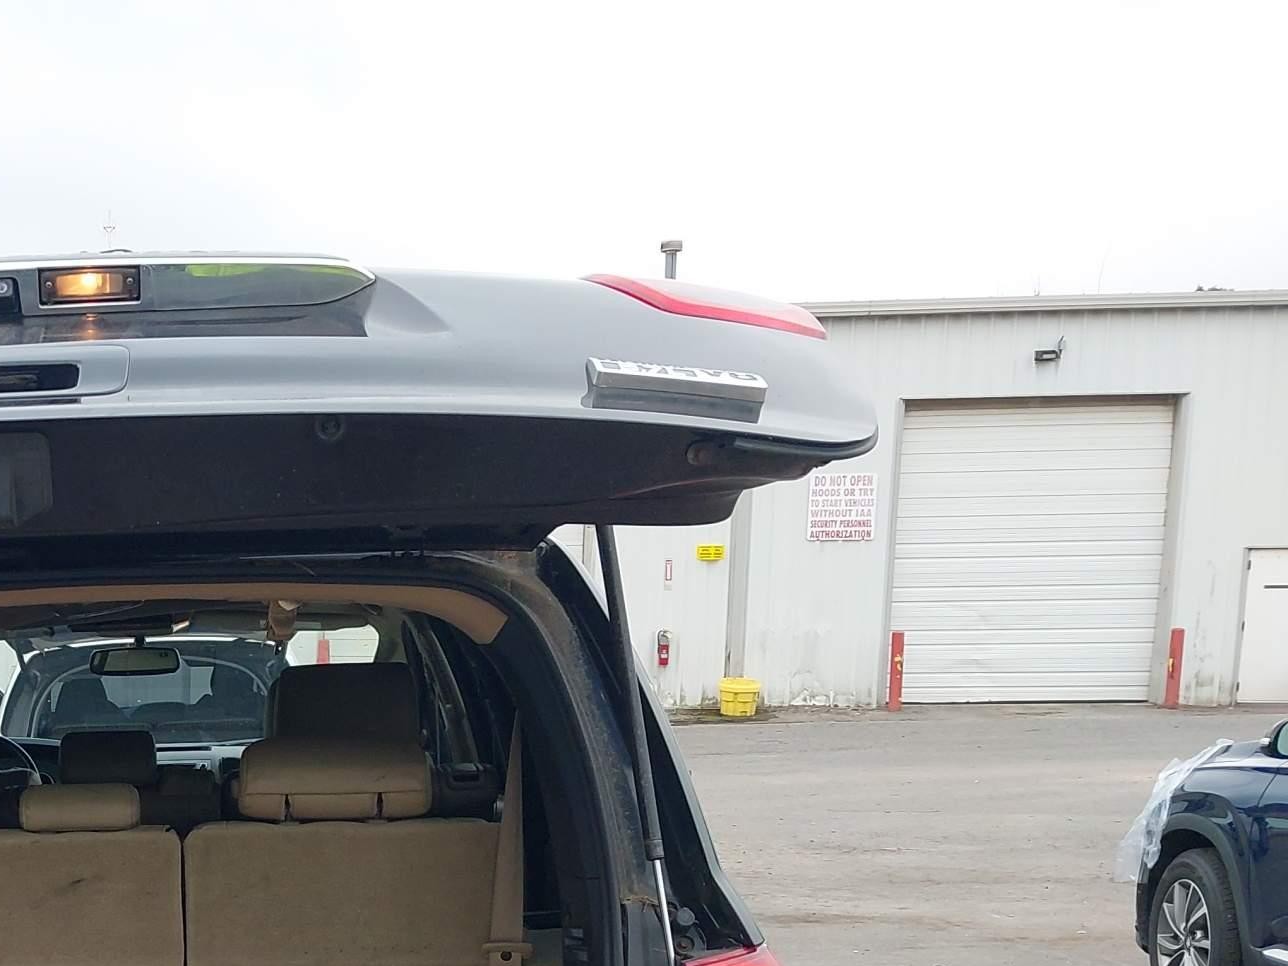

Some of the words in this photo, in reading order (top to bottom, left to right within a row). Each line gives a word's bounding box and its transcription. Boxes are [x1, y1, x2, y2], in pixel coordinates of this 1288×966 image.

[814, 476, 826, 487] DO
[829, 475, 847, 486] NOT
[850, 475, 873, 486] OPEN
[811, 488, 840, 497] HOODS
[843, 488, 856, 497] OR
[858, 488, 874, 496] TRY
[810, 499, 820, 508] TO
[821, 498, 842, 508] START
[844, 498, 874, 507] VEHICLES
[810, 509, 852, 518] WITHOUT
[855, 509, 872, 517] IAA
[810, 520, 837, 528] SECURITY
[839, 519, 872, 528] PERSONNEL
[810, 530, 872, 538] AUTHORIZATION
